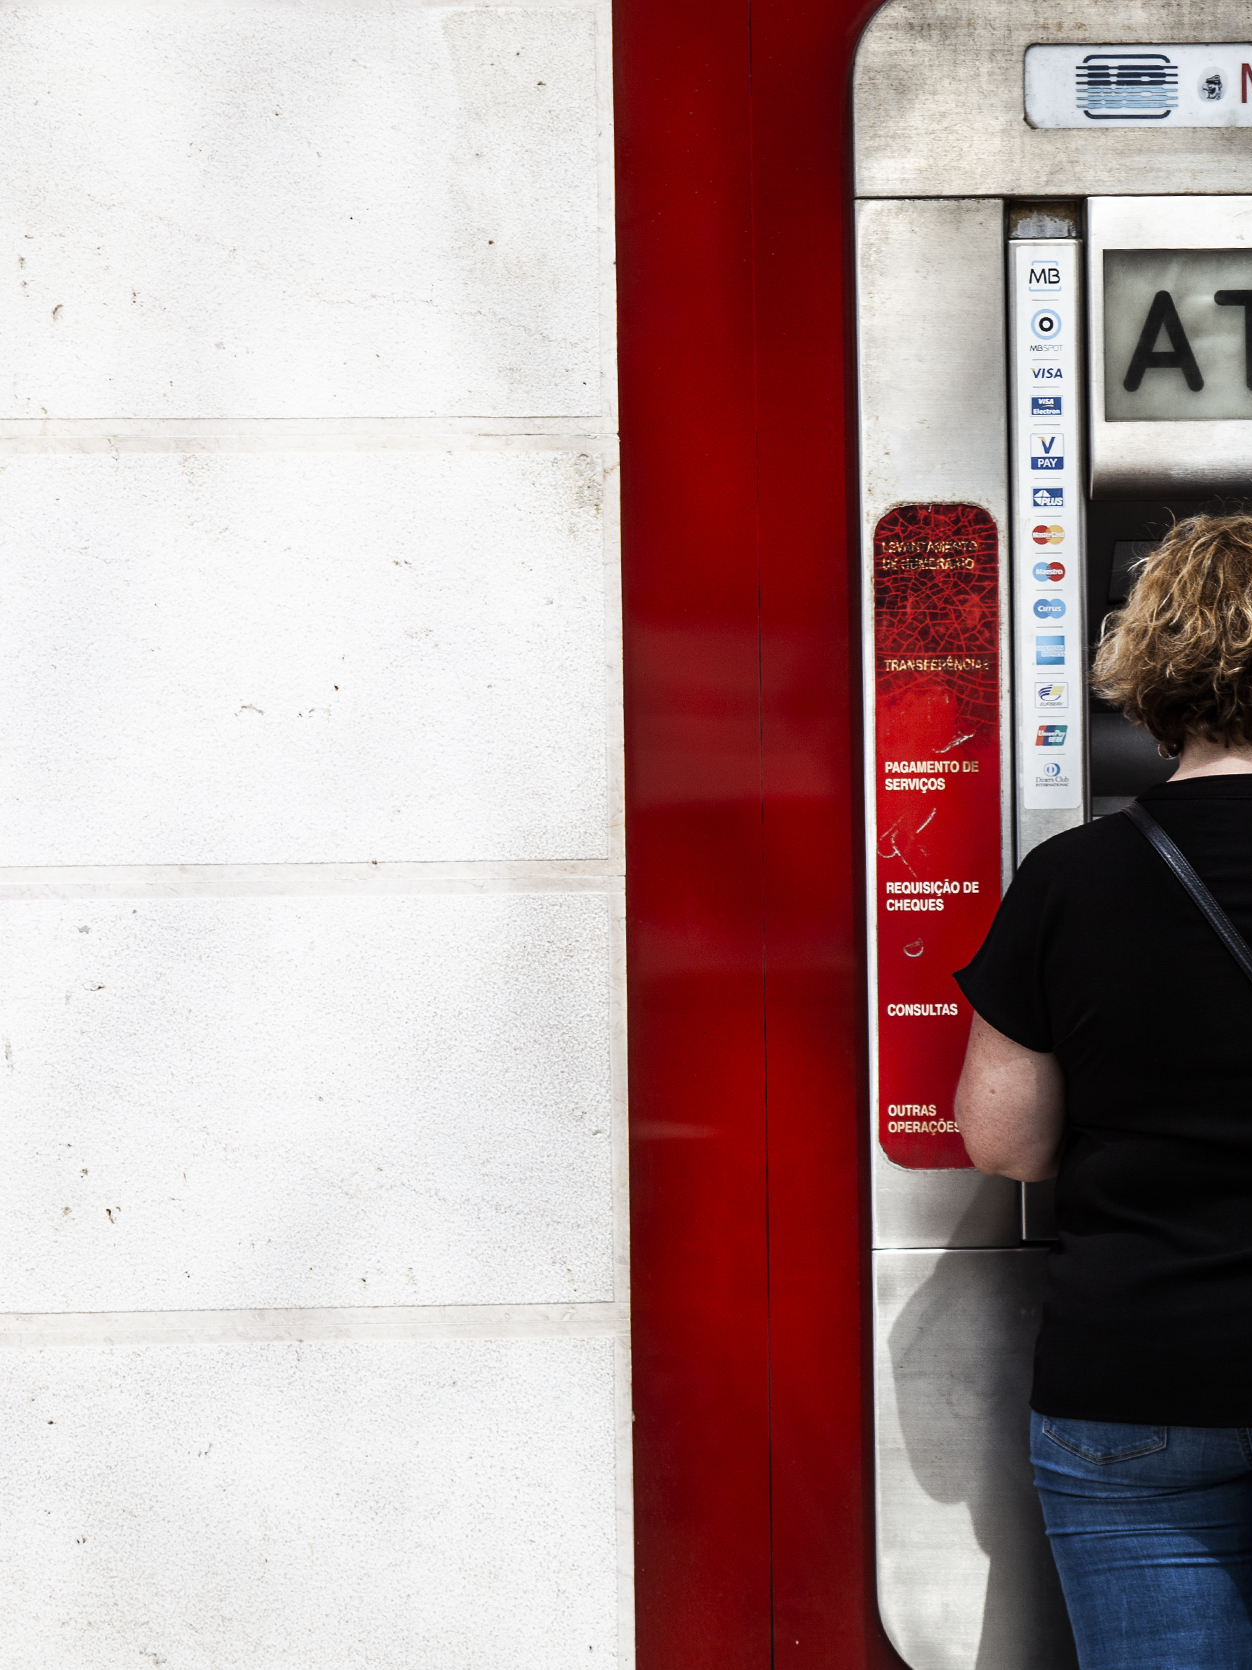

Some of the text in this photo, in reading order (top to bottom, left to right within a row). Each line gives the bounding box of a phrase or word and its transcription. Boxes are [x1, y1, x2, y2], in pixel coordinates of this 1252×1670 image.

[1029, 268, 1061, 284] MB
[1030, 368, 1063, 379] VISA
[1037, 436, 1056, 454] V
[1037, 458, 1058, 468] PAY
[1041, 497, 1063, 506] PLUS
[882, 541, 978, 553] LEVANTAMENTO
[884, 656, 990, 671] TRANSFERÊNCIAS
[885, 761, 979, 773] PAGAMENTO DE
[885, 778, 946, 793] SERVIÇOS
[886, 879, 979, 896] REQUISIÇÃO DE
[886, 899, 944, 911] CHEQUES
[887, 1003, 958, 1016] CONSULTAS
[888, 1104, 937, 1116] OUTRAS
